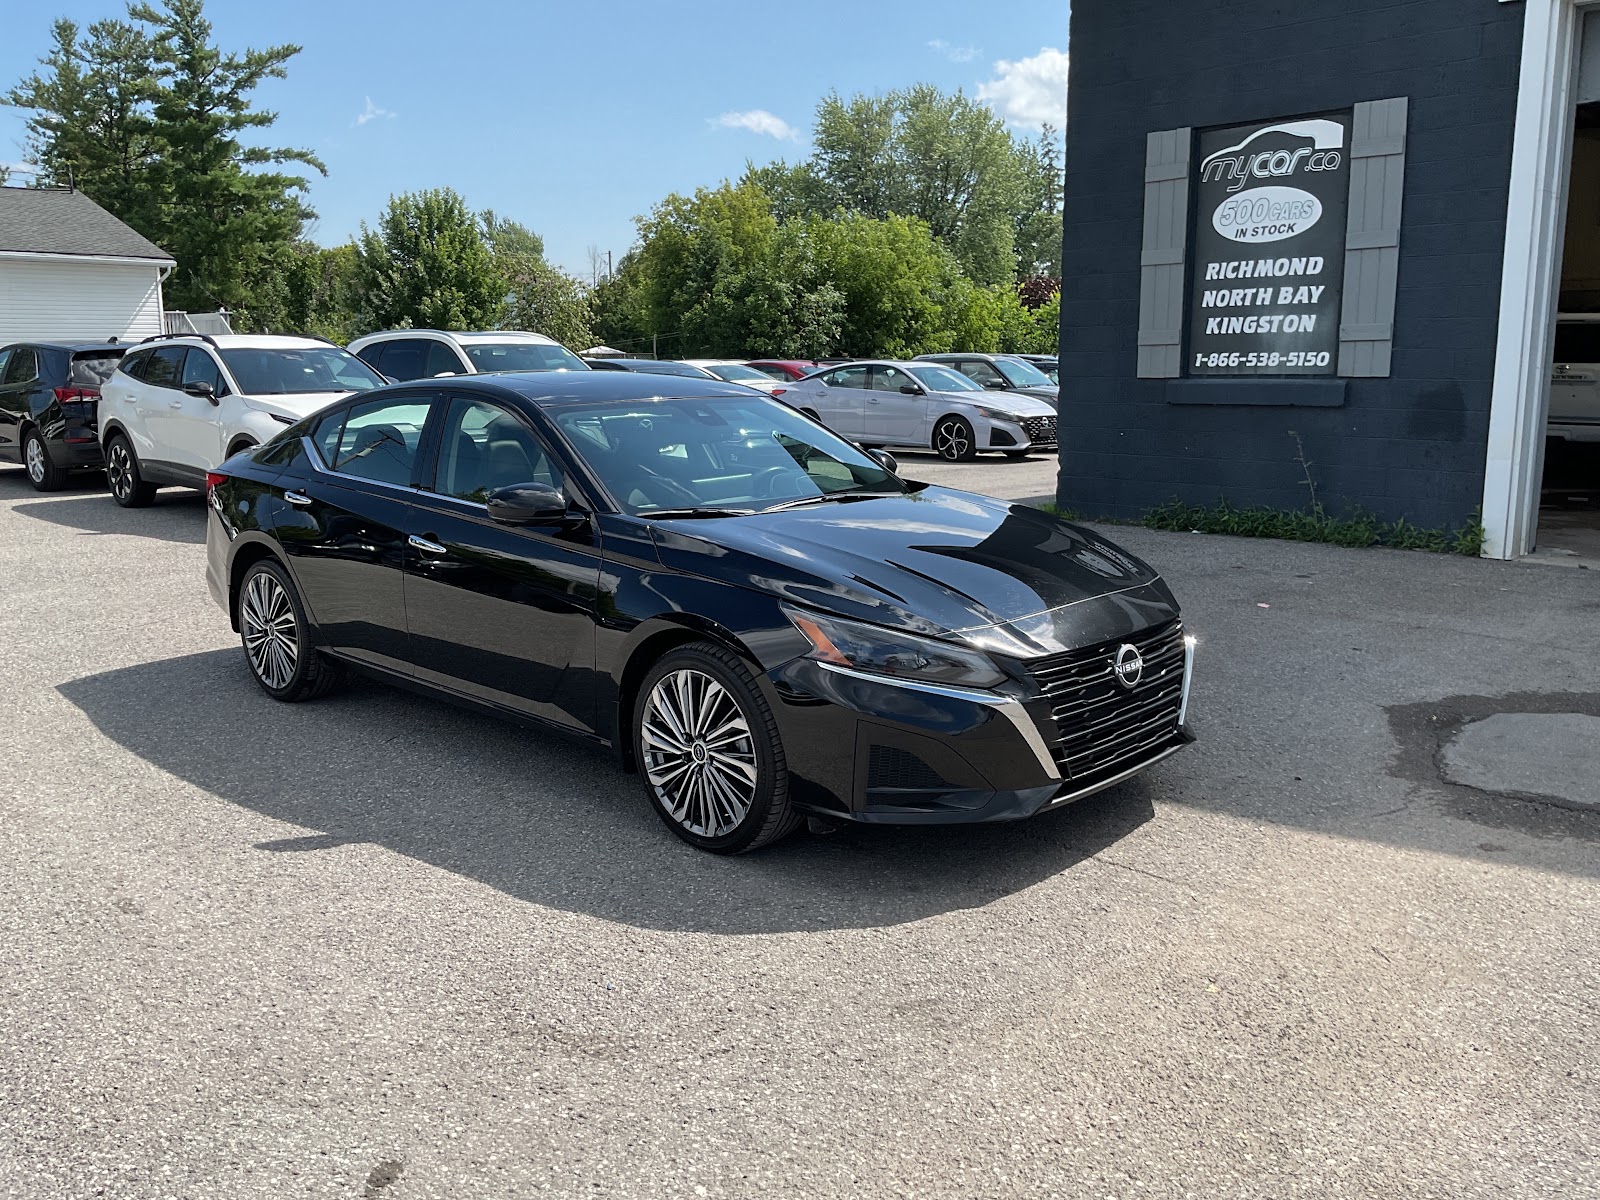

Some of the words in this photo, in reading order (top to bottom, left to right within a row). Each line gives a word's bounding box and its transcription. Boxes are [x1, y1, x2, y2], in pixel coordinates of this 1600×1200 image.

[1202, 147, 1341, 192] mycar.ca
[1235, 227, 1248, 239] IN
[1251, 223, 1297, 237] STOCK
[1205, 256, 1324, 281] RICHMOND
[1202, 287, 1273, 308] NORTH
[1277, 285, 1325, 305] BAY
[1205, 314, 1317, 335] KINGSTON
[1195, 352, 1330, 368] 1-866-538-5150
[1115, 659, 1143, 674] NISSAN
